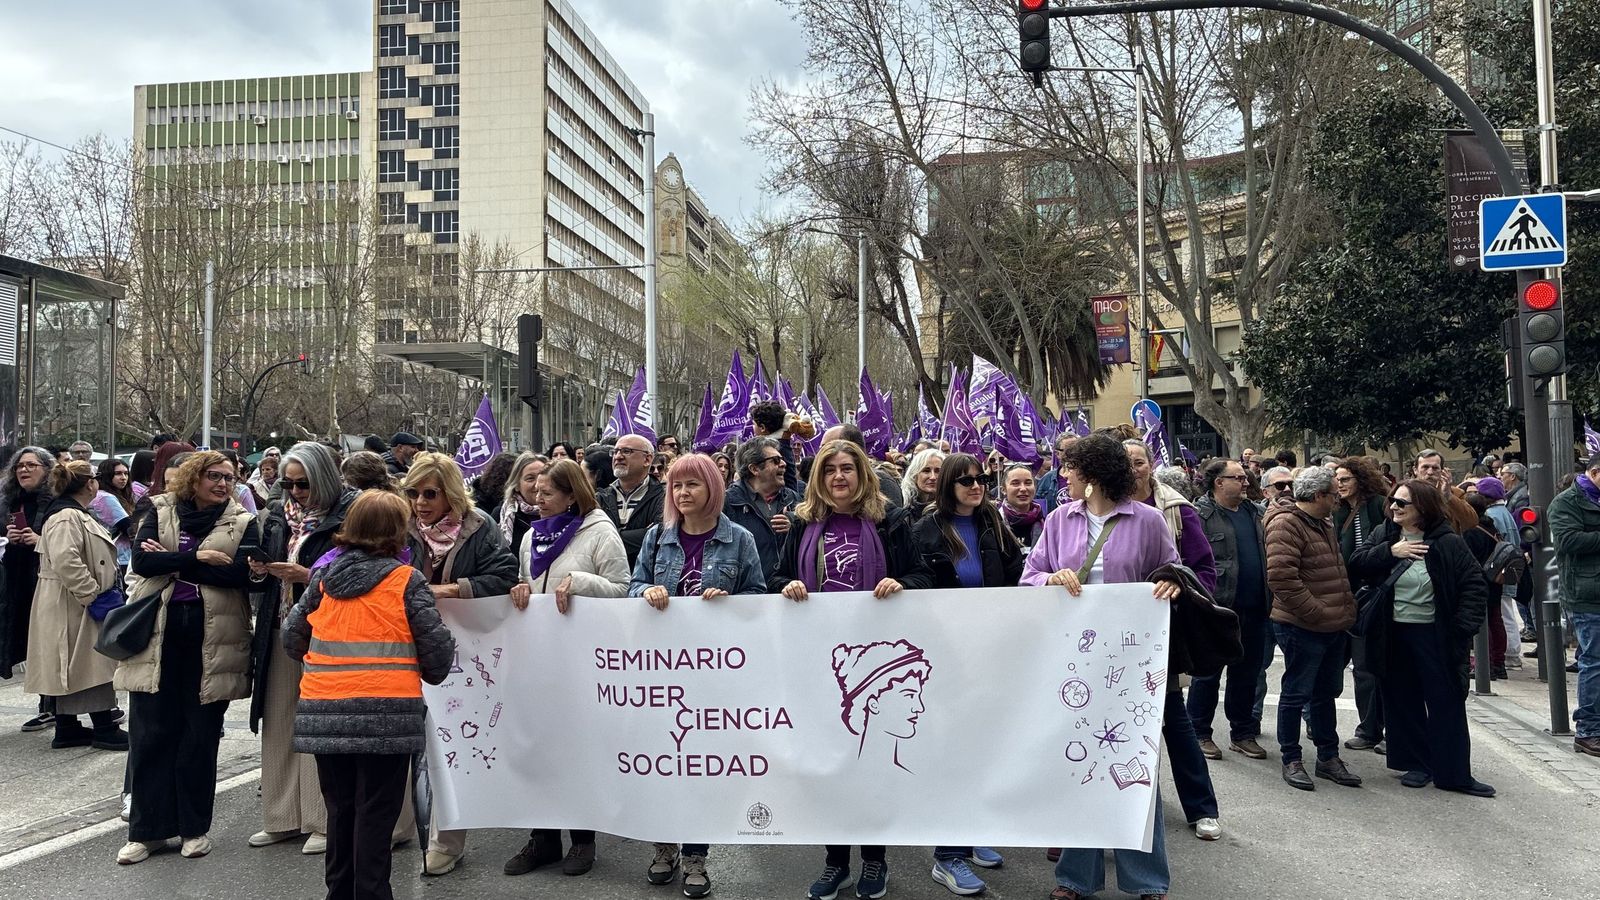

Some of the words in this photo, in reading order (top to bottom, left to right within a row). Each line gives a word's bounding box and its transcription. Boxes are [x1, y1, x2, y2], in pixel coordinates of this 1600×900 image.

[1093, 300, 1123, 313] MAO
[597, 682, 688, 711] MUJER
[669, 729, 689, 753] Y
